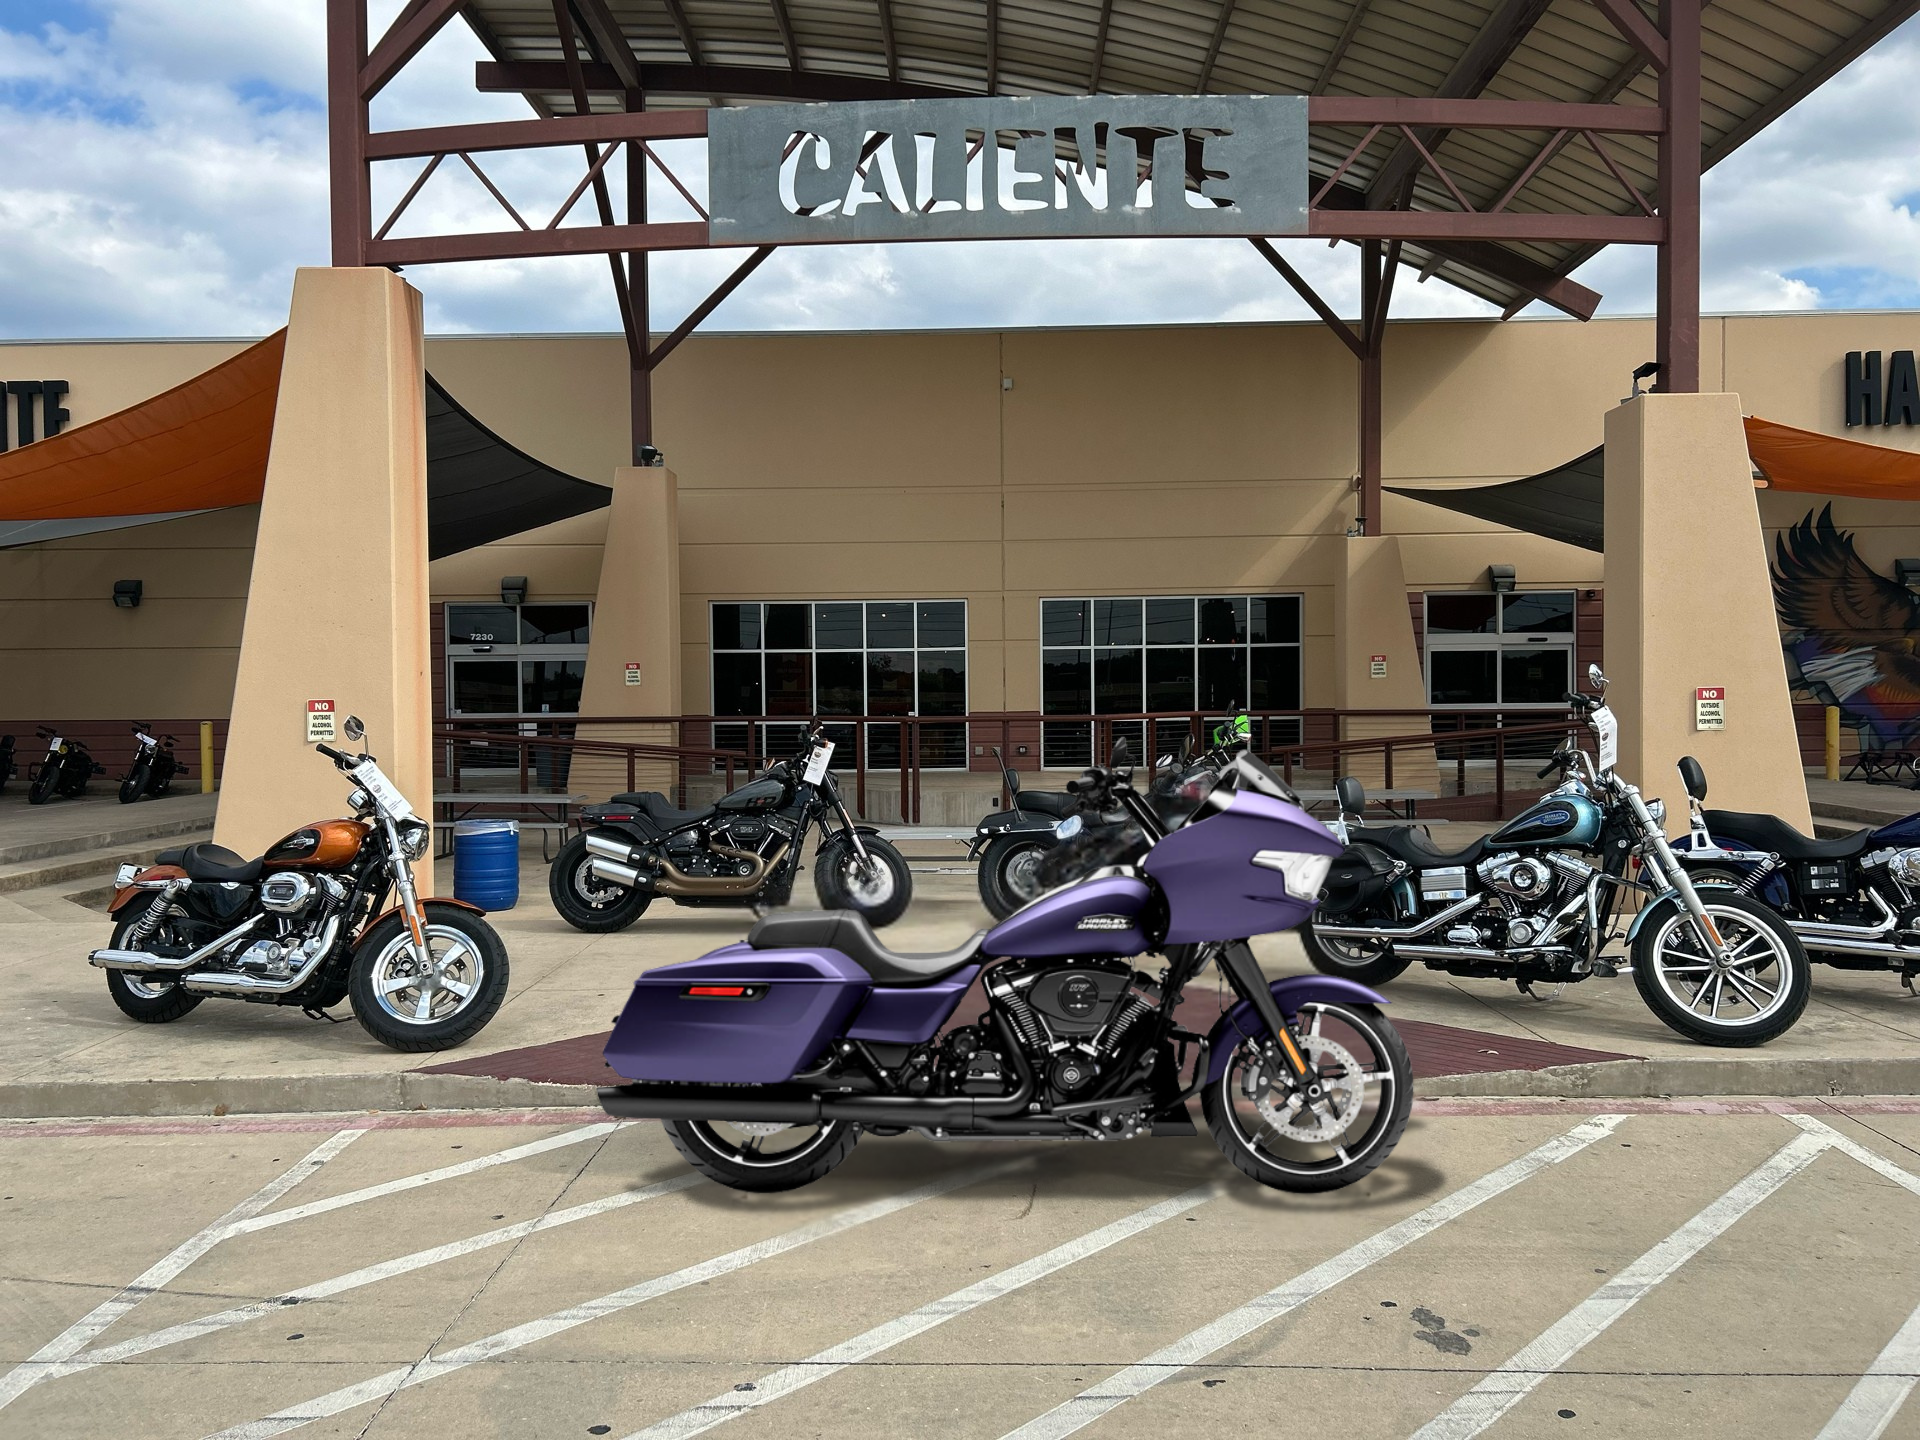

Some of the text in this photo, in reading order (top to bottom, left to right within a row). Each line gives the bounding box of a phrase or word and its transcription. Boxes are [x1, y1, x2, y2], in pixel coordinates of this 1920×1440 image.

[778, 121, 1236, 217] CALIENTE
[470, 633, 494, 641] 7230
[1702, 690, 1717, 698] NO
[314, 702, 329, 711] NO
